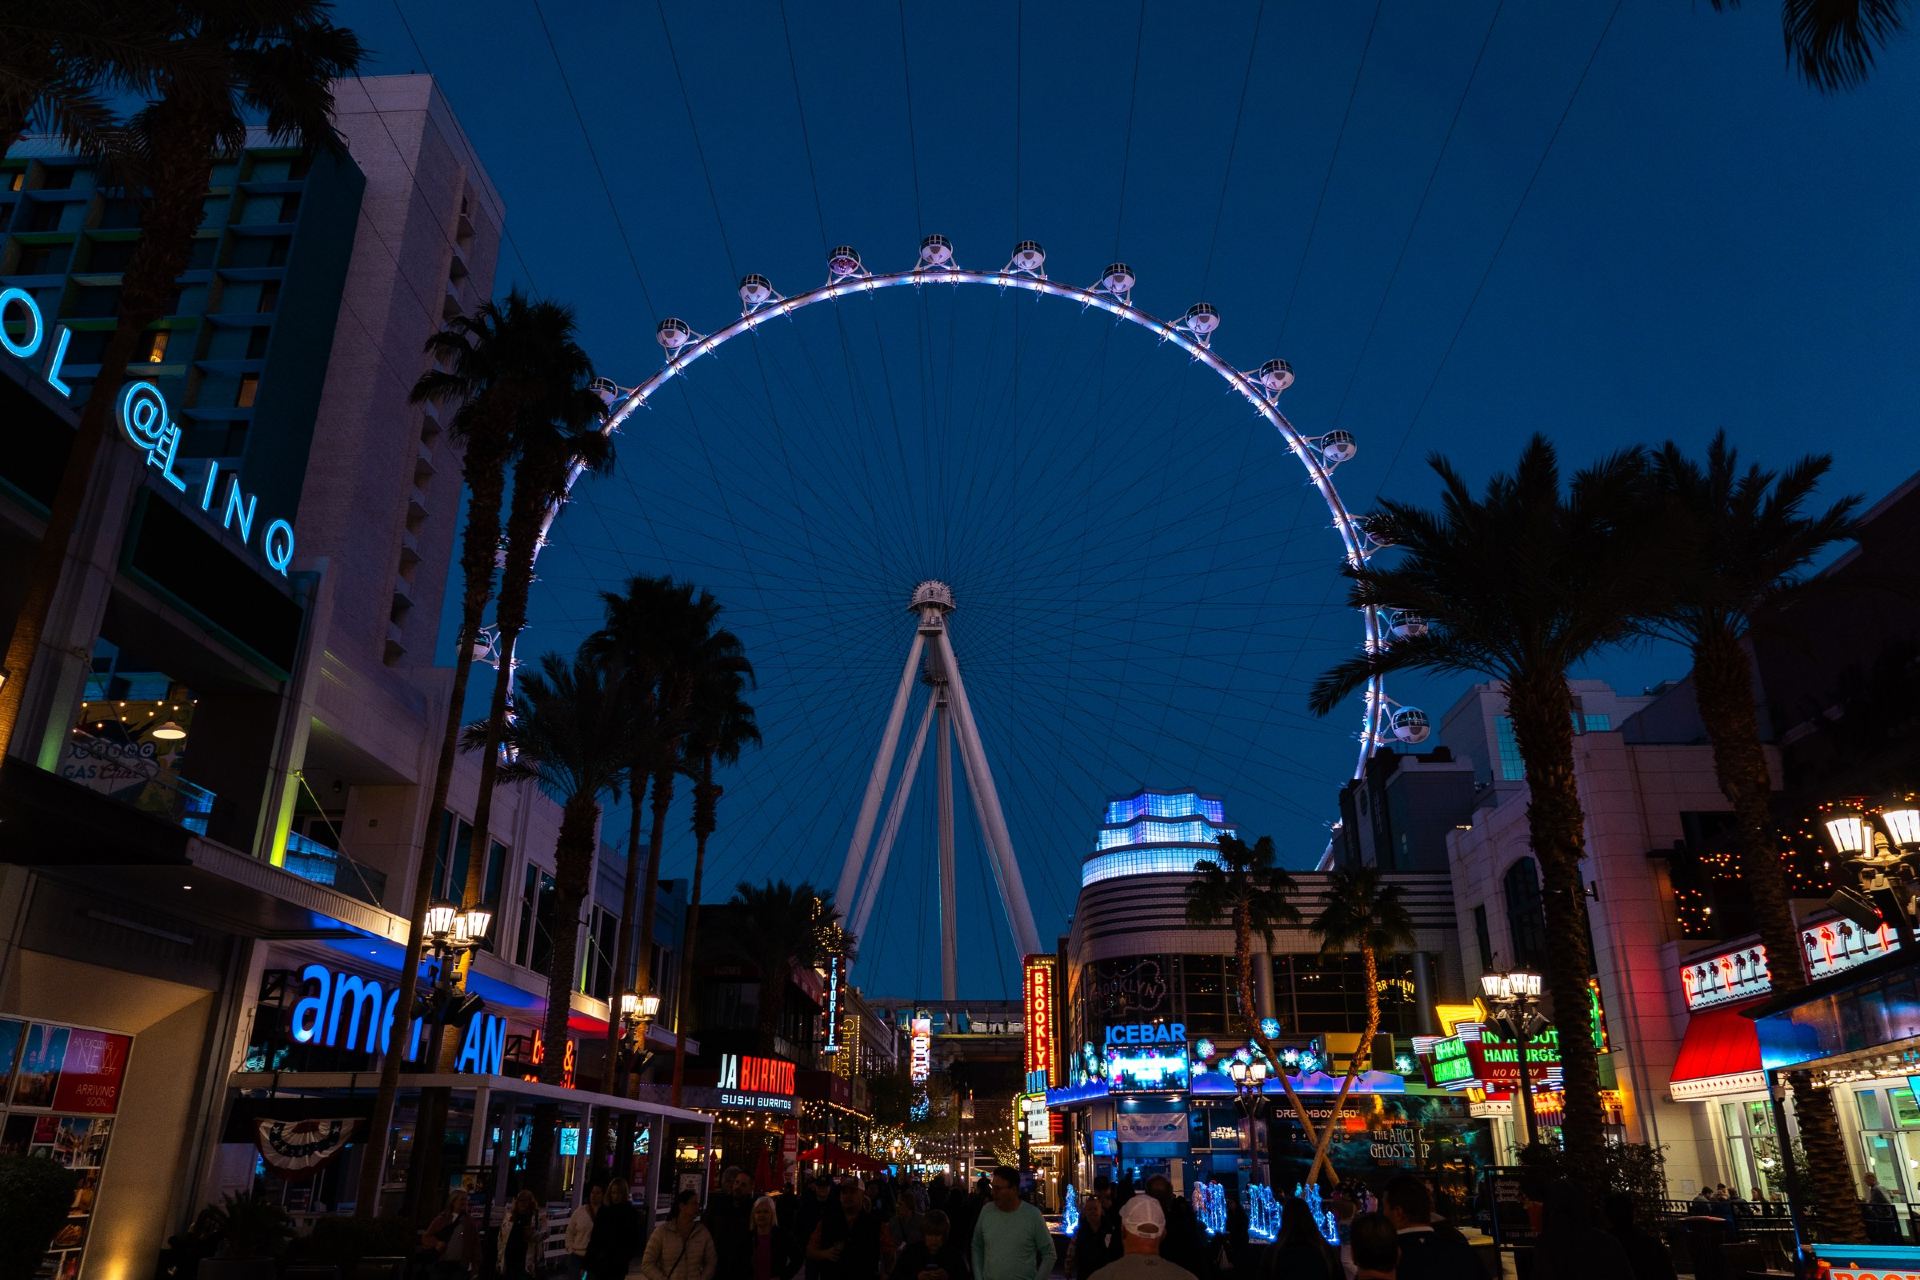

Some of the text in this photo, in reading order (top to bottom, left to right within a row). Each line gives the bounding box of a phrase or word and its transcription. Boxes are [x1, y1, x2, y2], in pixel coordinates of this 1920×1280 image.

[828, 957, 840, 1046] FAVORITE
[1106, 1023, 1186, 1044] ICEBAR
[840, 1018, 856, 1078] Ghirard
[77, 1047, 120, 1069] NEW
[1492, 1068, 1540, 1078] NO DEAY
[75, 1083, 116, 1098] ARRIVING
[721, 1094, 792, 1110] SUSHI BURRITOS
[1275, 1109, 1333, 1118] DREMBOX
[1372, 1130, 1389, 1140] THE
[1370, 1143, 1407, 1158] GHOST
